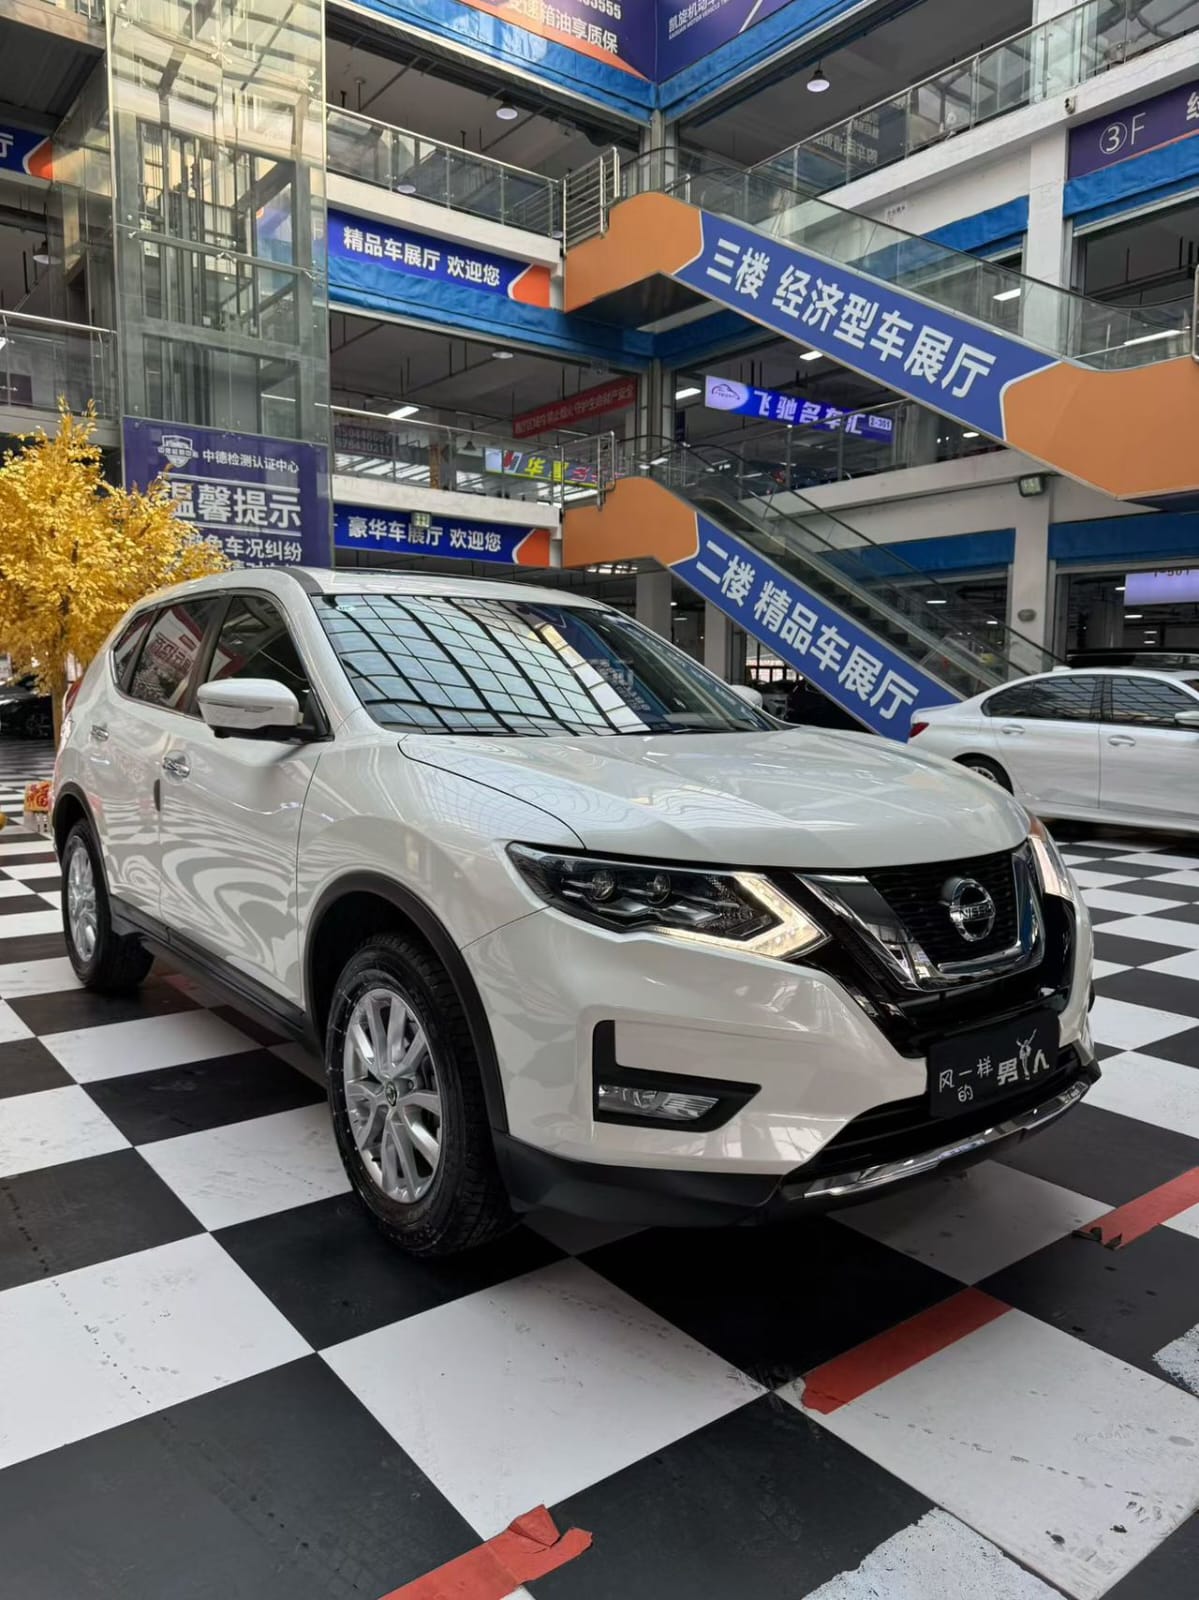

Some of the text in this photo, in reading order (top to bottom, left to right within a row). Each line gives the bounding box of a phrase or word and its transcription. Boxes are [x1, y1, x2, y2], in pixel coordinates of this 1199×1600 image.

[343, 225, 441, 272] 精品车展厅
[447, 254, 501, 287] 欢迎您
[706, 238, 997, 399] 三楼 经济型车展厅
[754, 390, 866, 435] 飞驰名车汇
[202, 449, 300, 474] 中德检测认证中心
[347, 515, 443, 547] 豪华车展厅
[450, 527, 502, 553] 欢迎您
[696, 540, 756, 608] 二楼
[753, 580, 920, 720] 精品车展厅
[957, 1084, 974, 1103] 的
